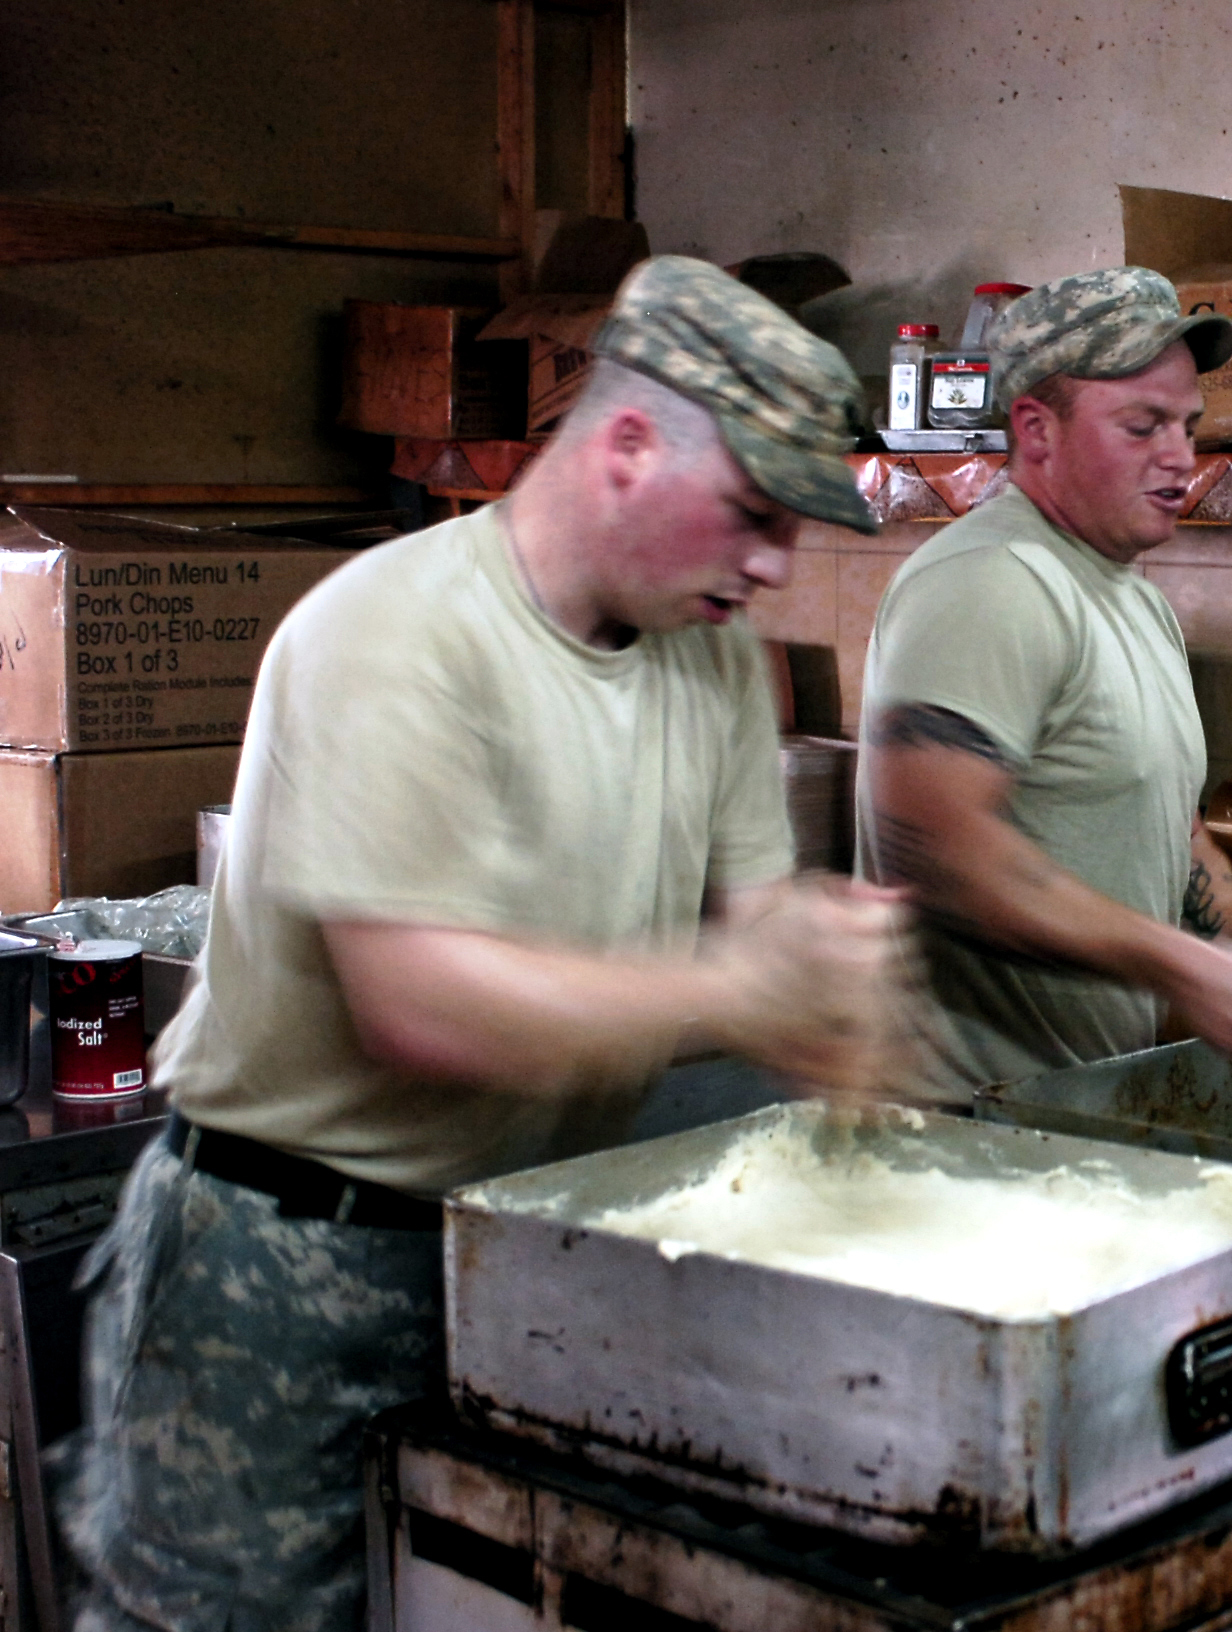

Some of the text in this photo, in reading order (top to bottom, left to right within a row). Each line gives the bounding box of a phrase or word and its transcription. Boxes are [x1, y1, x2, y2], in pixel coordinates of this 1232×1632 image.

[75, 561, 260, 586] Lun/Din Menu 14
[76, 592, 194, 619] Pork Chops
[76, 618, 260, 646] 8970-01-E10-0227
[77, 650, 179, 674] Box 1 of 3
[78, 697, 99, 710] Box
[112, 697, 122, 709] of
[136, 695, 154, 711] Dry
[79, 713, 99, 726] Box
[103, 713, 110, 725] 2
[112, 712, 123, 725] of
[136, 711, 154, 727] Dry
[79, 729, 99, 742] Box
[103, 729, 110, 741] 3
[112, 728, 123, 741] of
[78, 1031, 103, 1046] Salt
